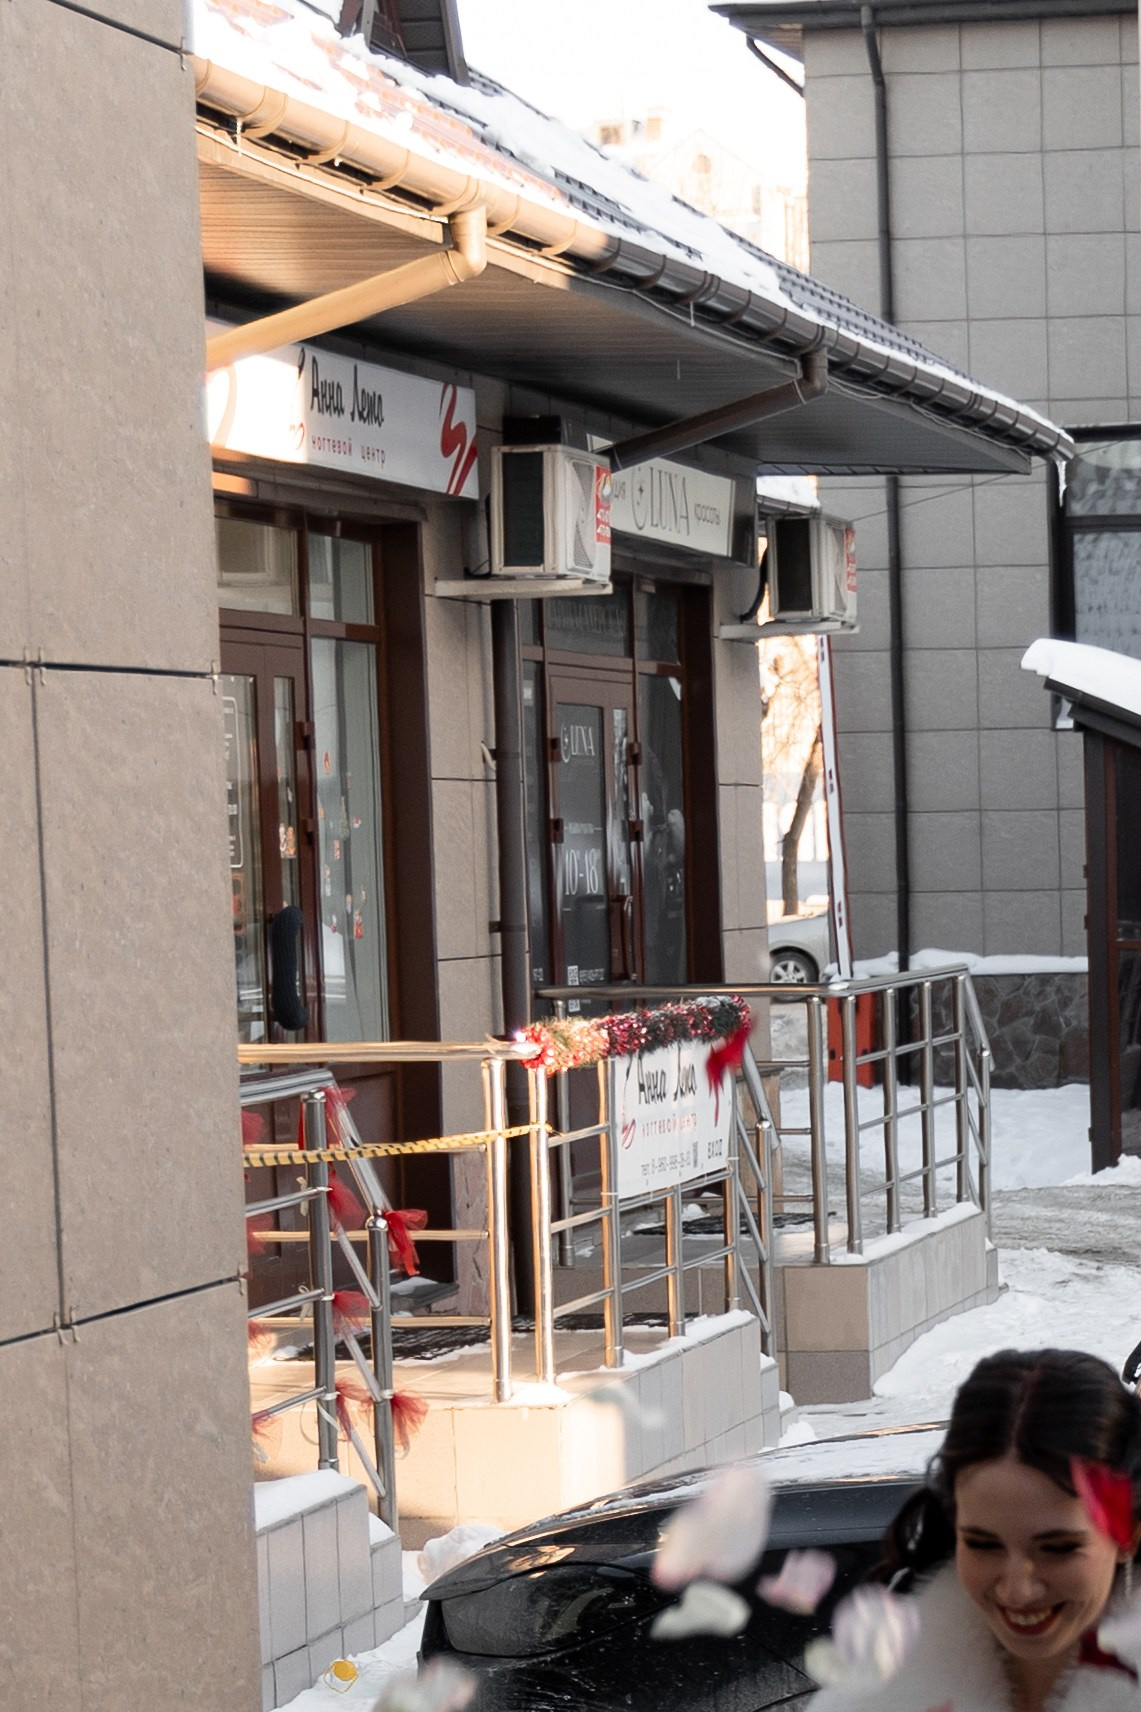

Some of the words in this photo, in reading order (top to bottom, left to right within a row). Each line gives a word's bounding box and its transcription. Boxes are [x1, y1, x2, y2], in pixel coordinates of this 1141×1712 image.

[310, 355, 344, 417] Анна
[350, 363, 385, 427] Лето
[312, 436, 353, 456] ногтевой
[361, 445, 386, 468] центр
[650, 467, 690, 535] LUNA
